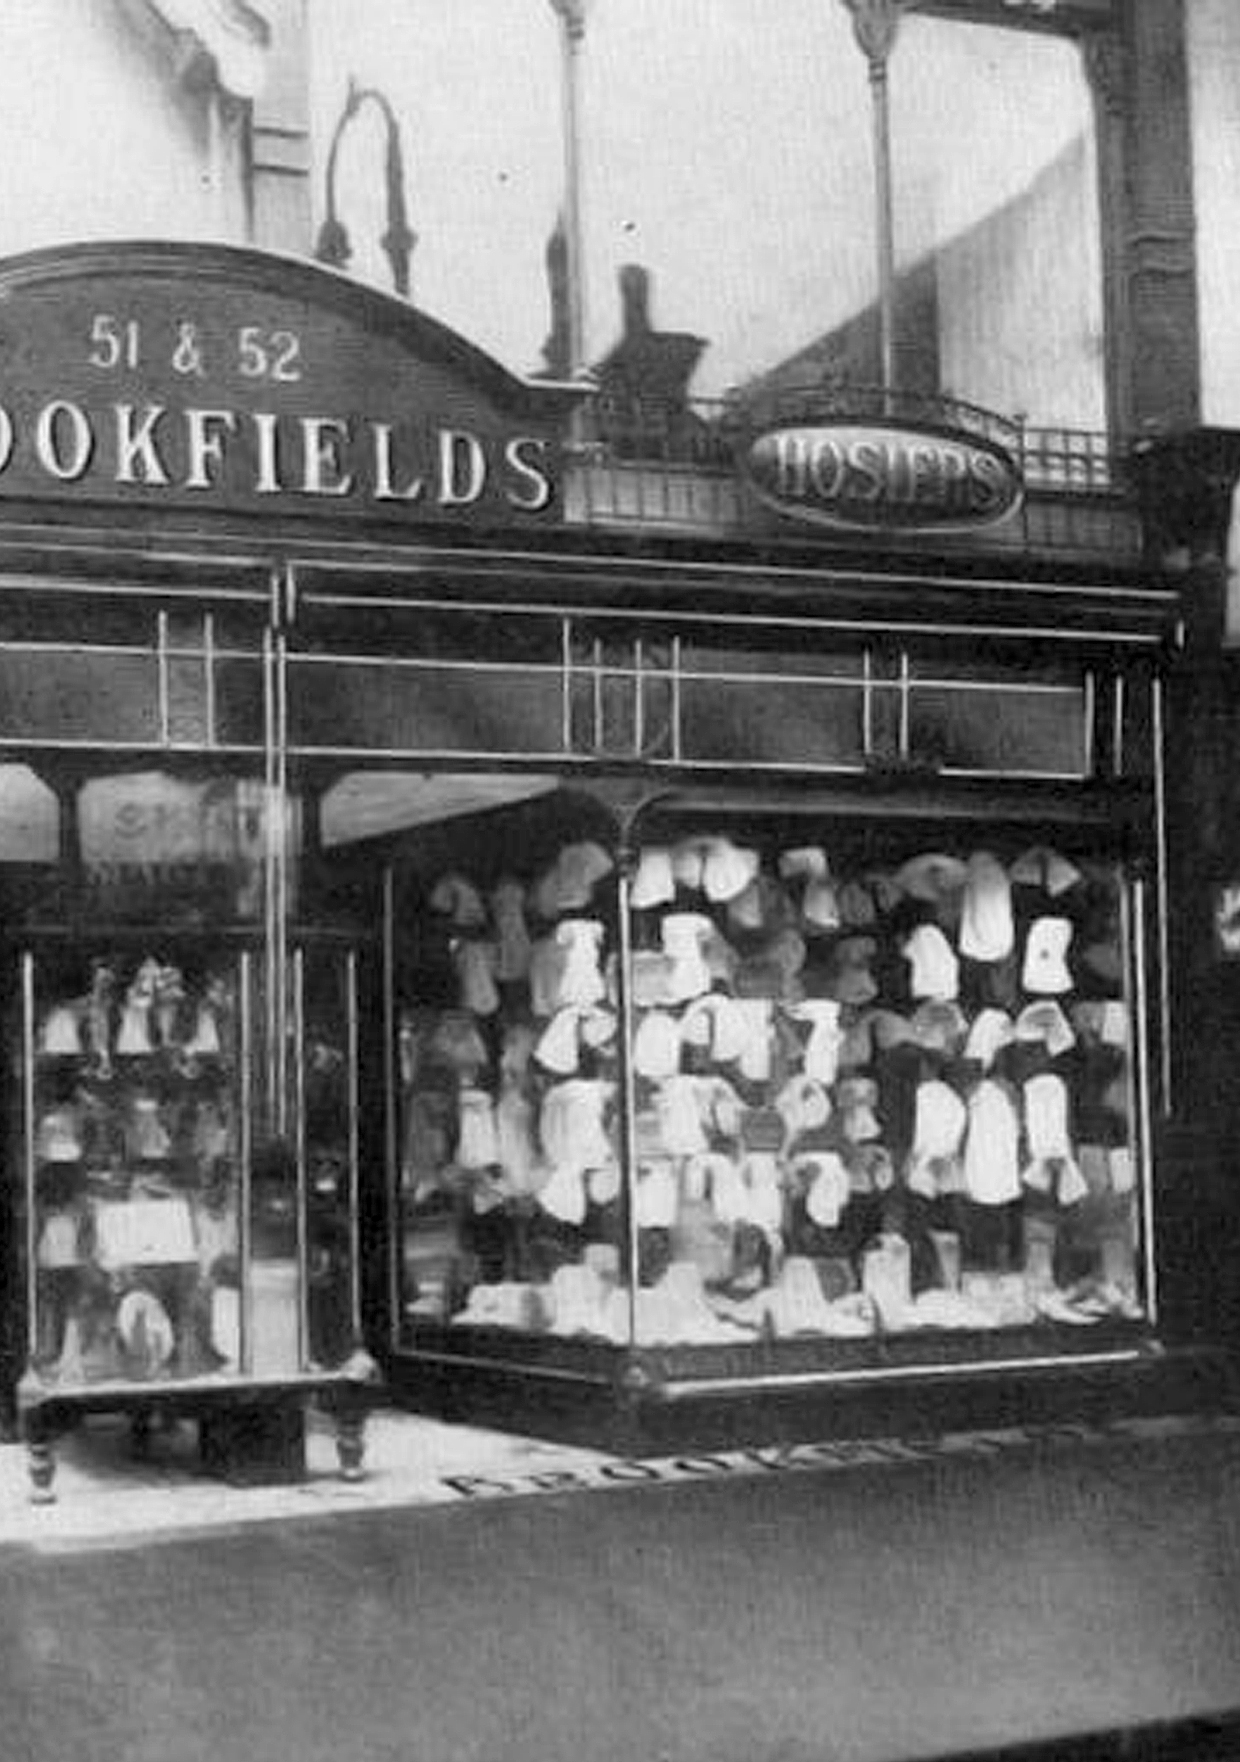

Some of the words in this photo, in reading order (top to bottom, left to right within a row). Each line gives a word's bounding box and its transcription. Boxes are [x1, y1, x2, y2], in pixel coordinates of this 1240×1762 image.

[89, 314, 139, 370] 51
[171, 322, 206, 378] &
[238, 327, 302, 382] 52
